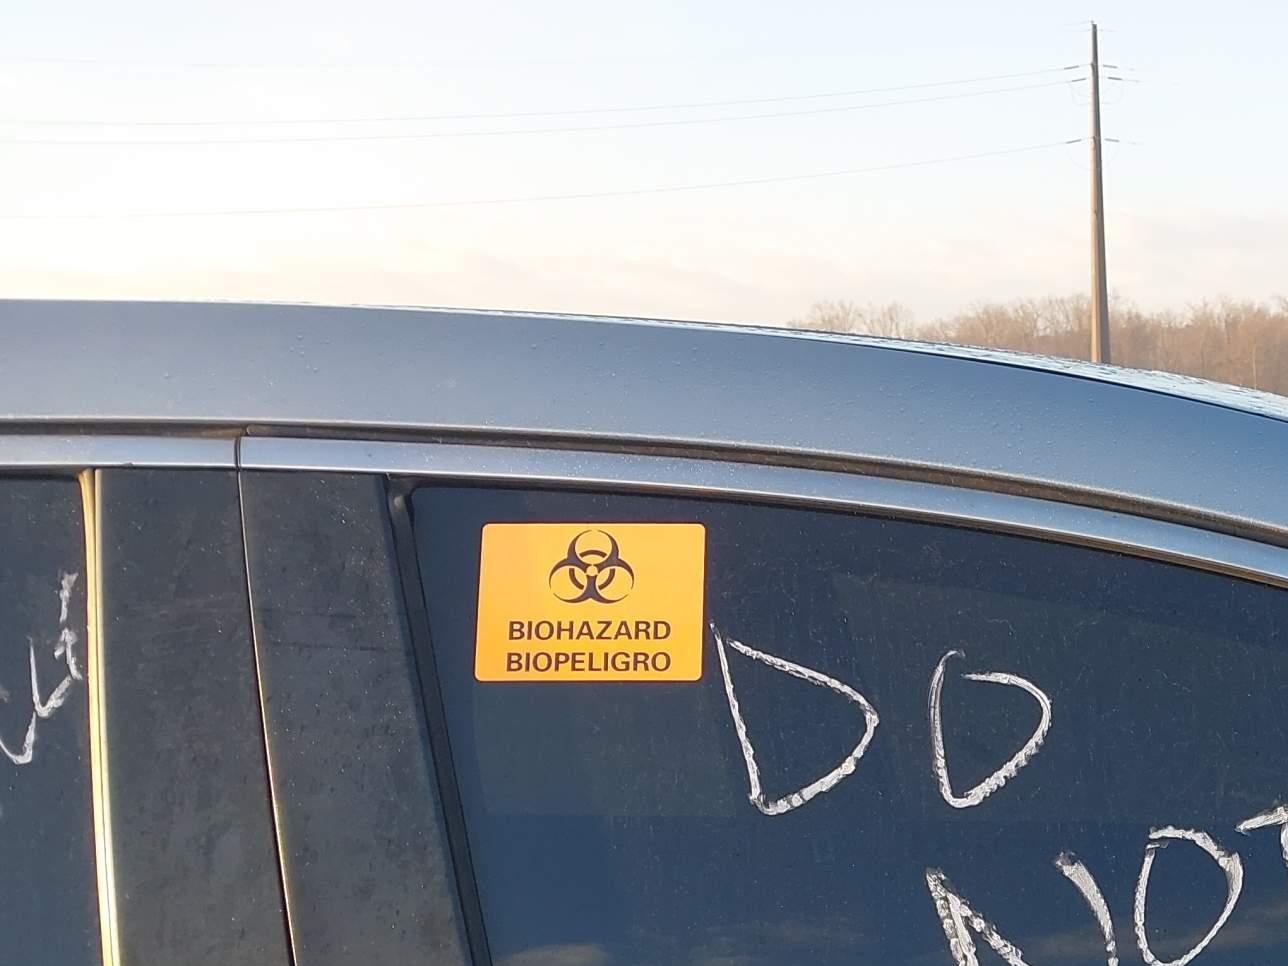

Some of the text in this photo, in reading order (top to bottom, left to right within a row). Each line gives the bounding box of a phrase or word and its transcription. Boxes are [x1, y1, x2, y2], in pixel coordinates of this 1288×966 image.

[507, 619, 672, 641] BIOHAZARD
[506, 651, 672, 672] BIOPELIGRO
[710, 621, 1053, 816] DO
